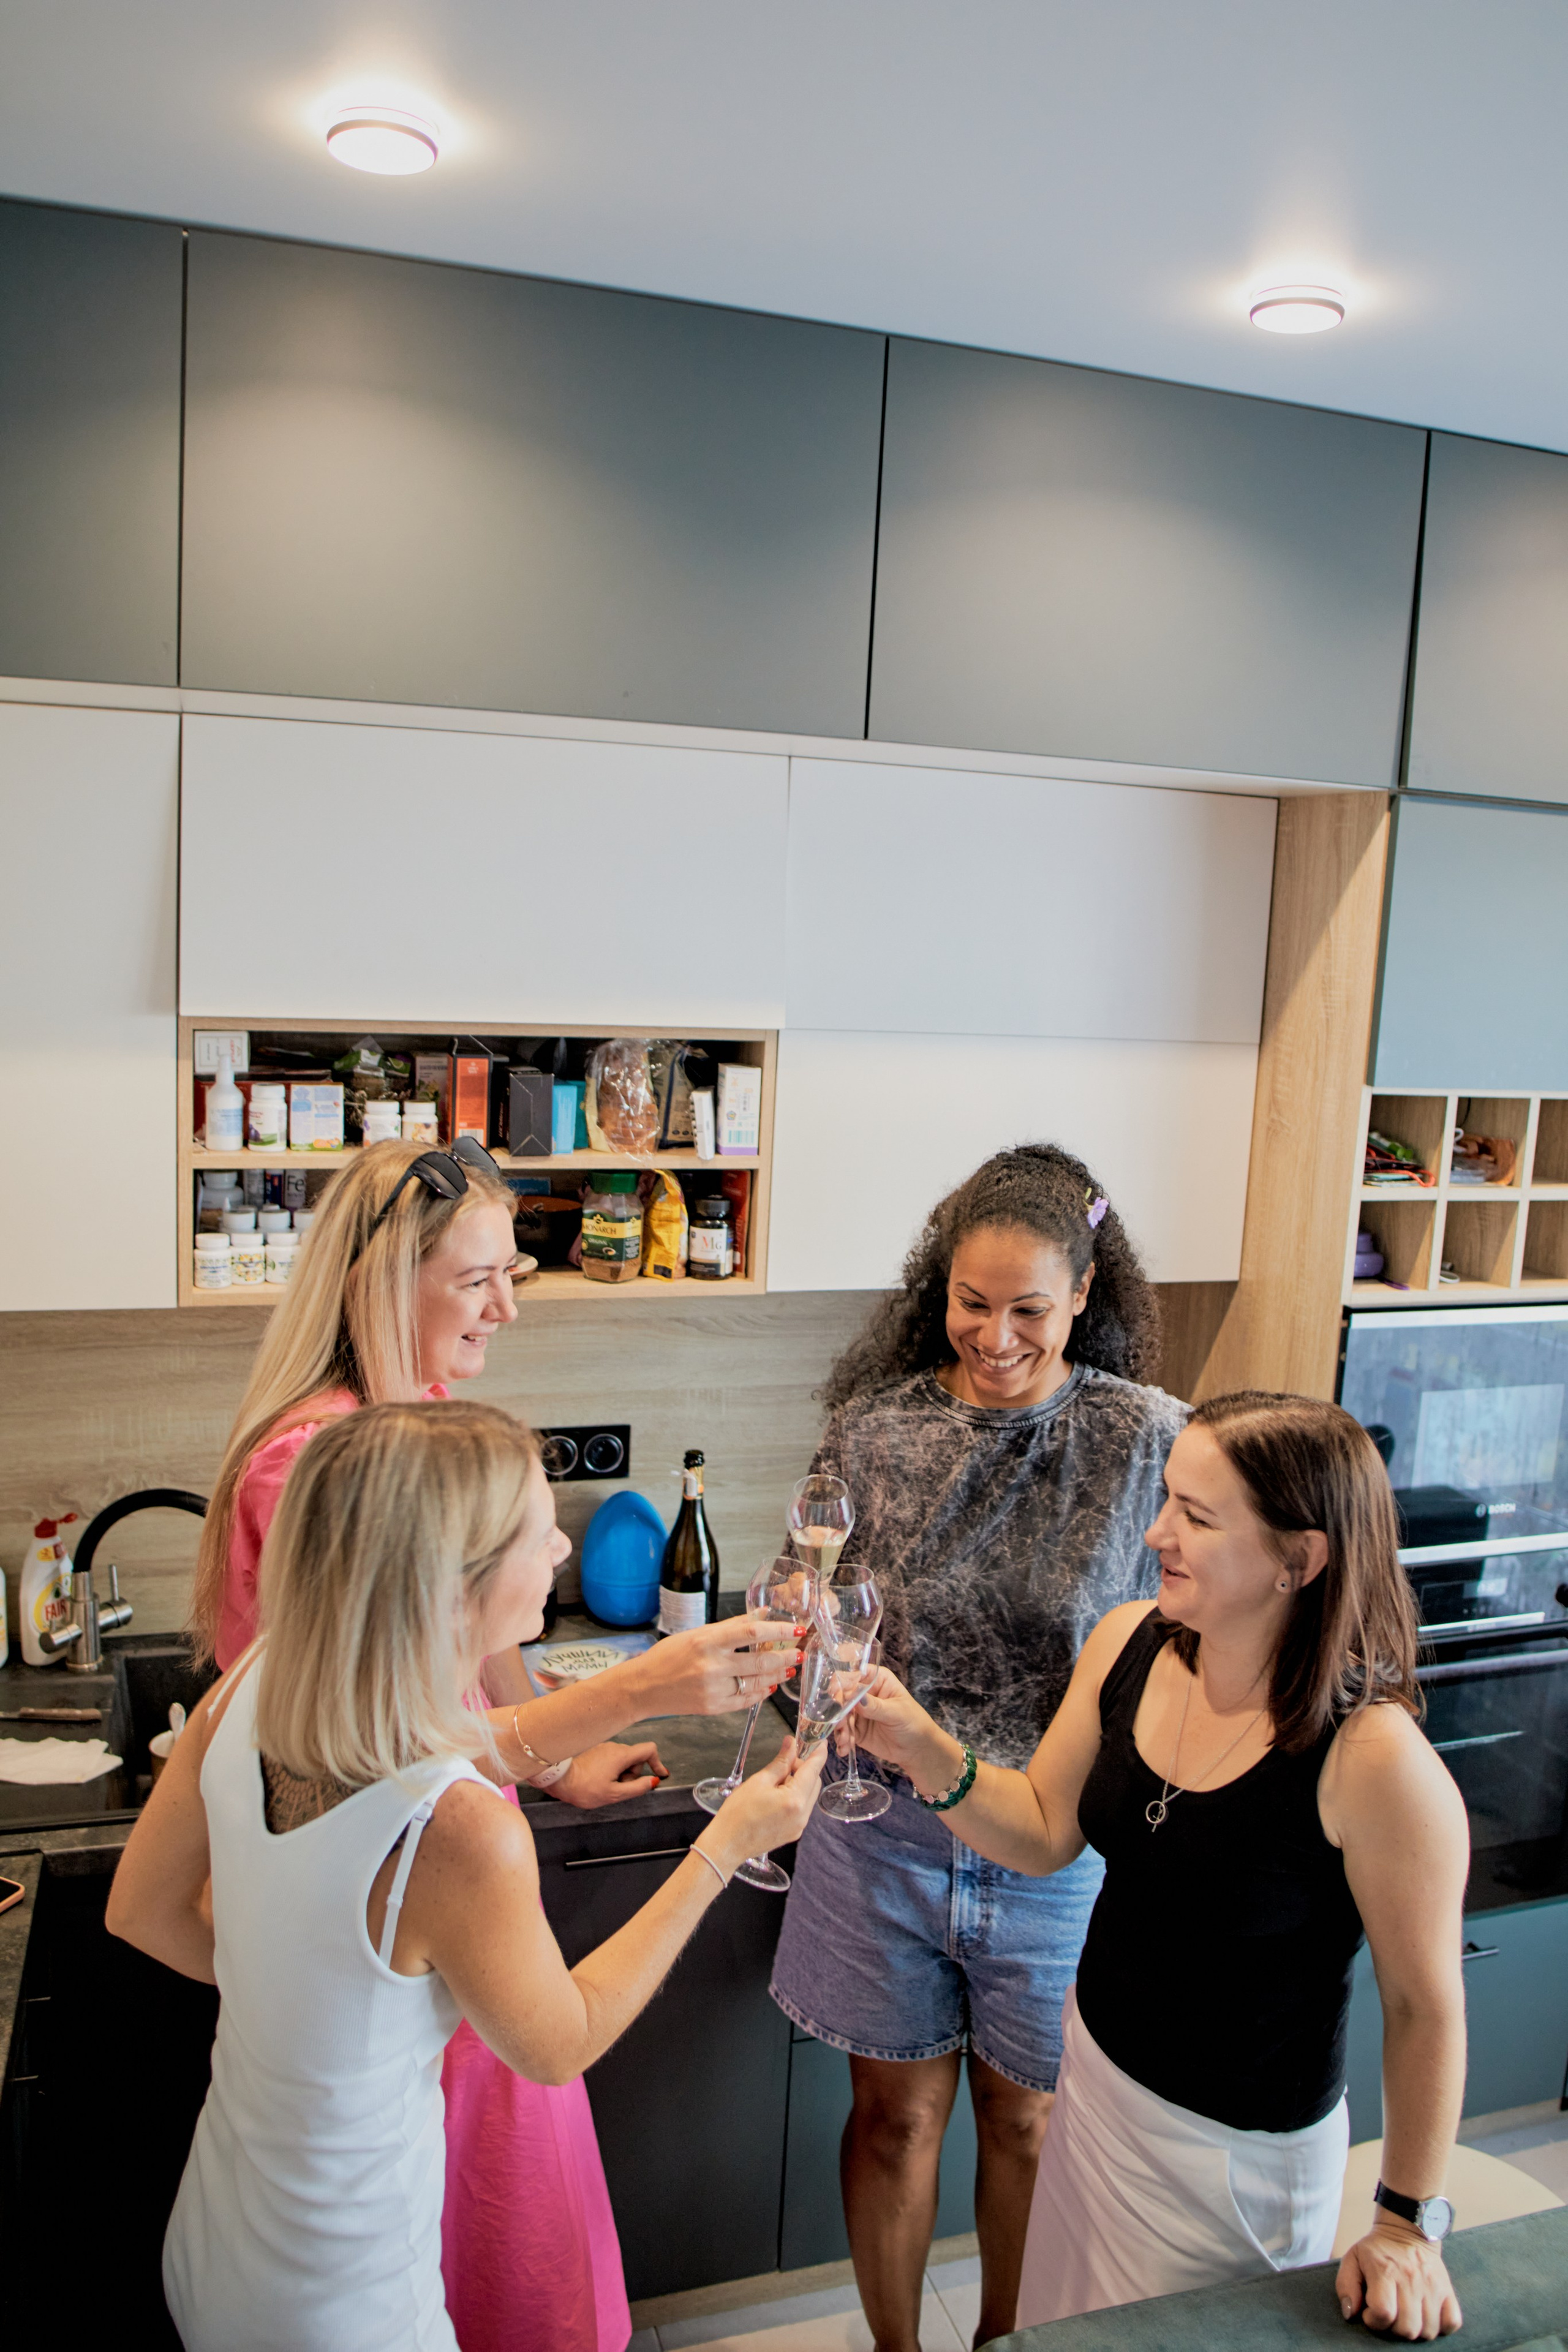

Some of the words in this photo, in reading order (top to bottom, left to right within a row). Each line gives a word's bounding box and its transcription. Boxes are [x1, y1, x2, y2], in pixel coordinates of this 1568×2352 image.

[287, 1175, 305, 1192] Fe
[582, 1224, 616, 1235] MONARCH
[1488, 1503, 1516, 1515] BOSCH
[45, 1599, 67, 1621] FAIR
[542, 1649, 619, 1667] ЛУЧШИЙ
